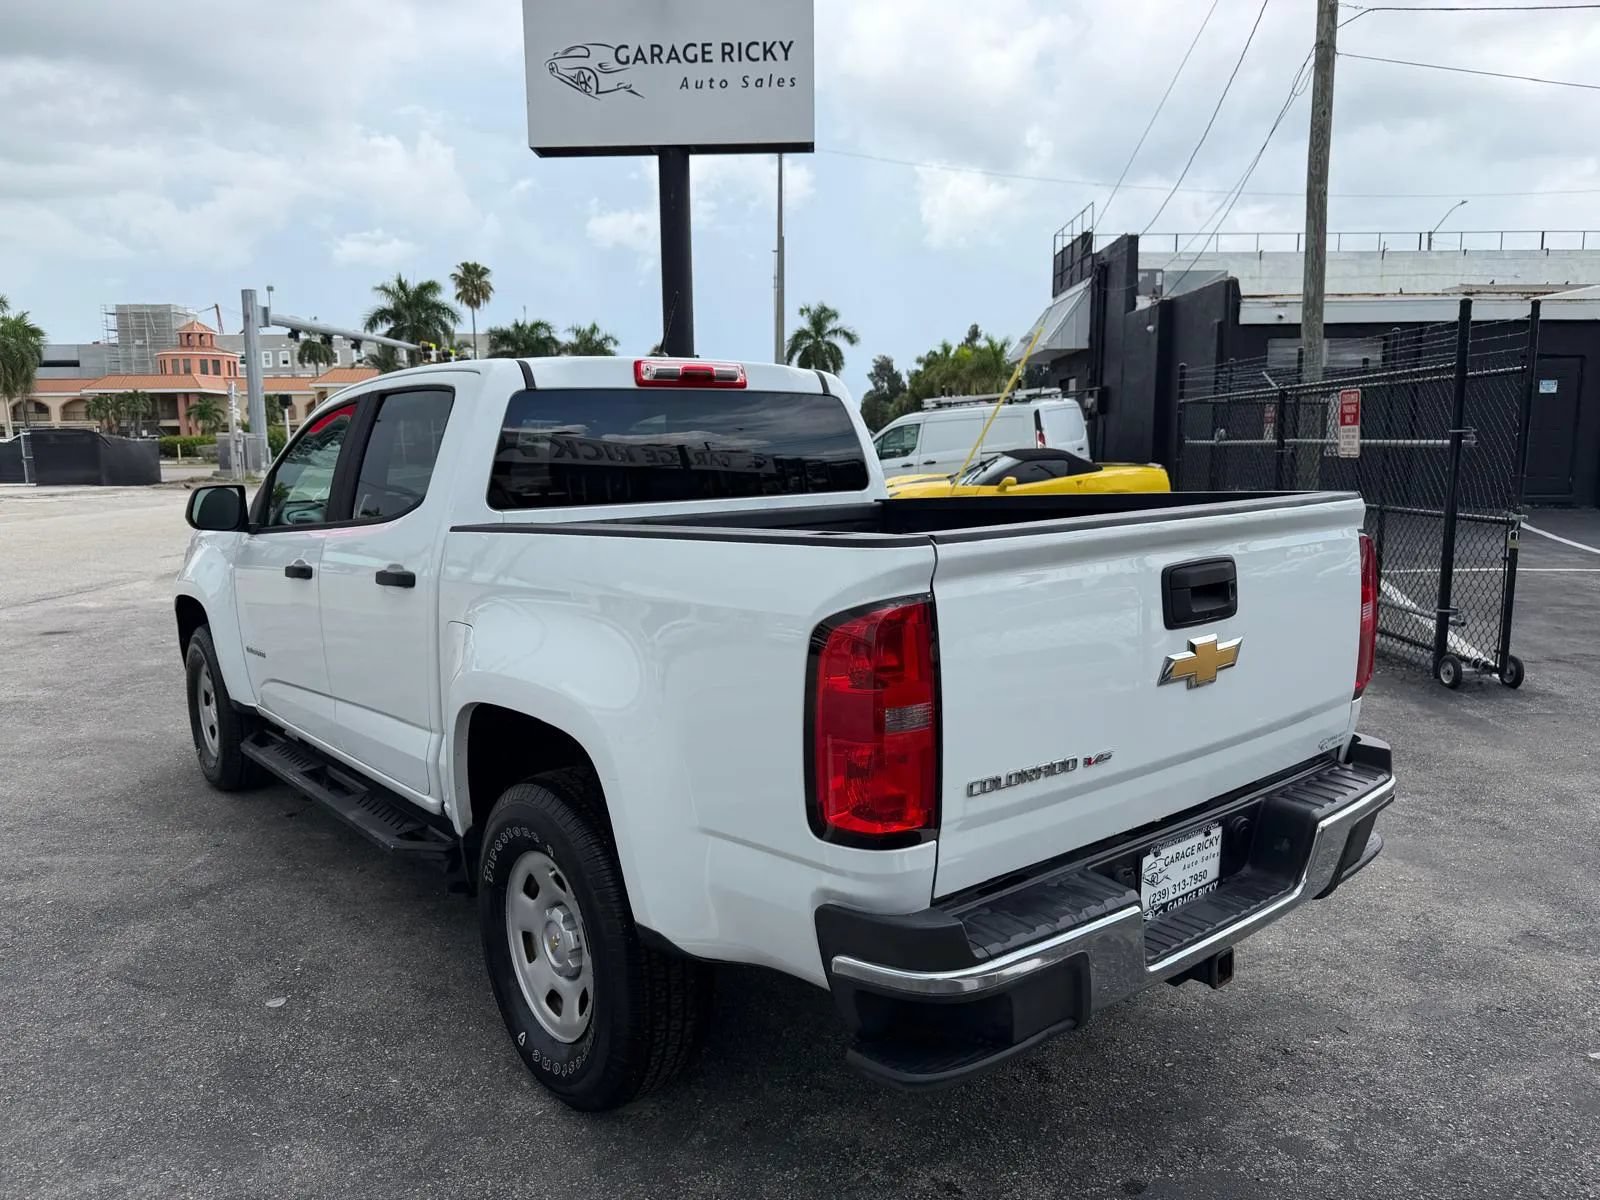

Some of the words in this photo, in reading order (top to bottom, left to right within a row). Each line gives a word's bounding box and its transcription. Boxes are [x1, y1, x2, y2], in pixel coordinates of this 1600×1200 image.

[614, 42, 714, 65] GARAGE
[721, 40, 795, 63] RICKY
[680, 76, 729, 90] Auto
[741, 73, 797, 89] Sales
[966, 755, 1078, 797] COLORADO
[1164, 845, 1196, 867] GARAGE
[1197, 835, 1220, 853] RICKY
[1182, 861, 1199, 871] Auto
[1201, 852, 1220, 863] Sales
[1149, 887, 1170, 908] (239)
[1172, 869, 1208, 895] 313-7950
[1167, 890, 1196, 912] GARAGE
[1198, 881, 1219, 897] RICKY
